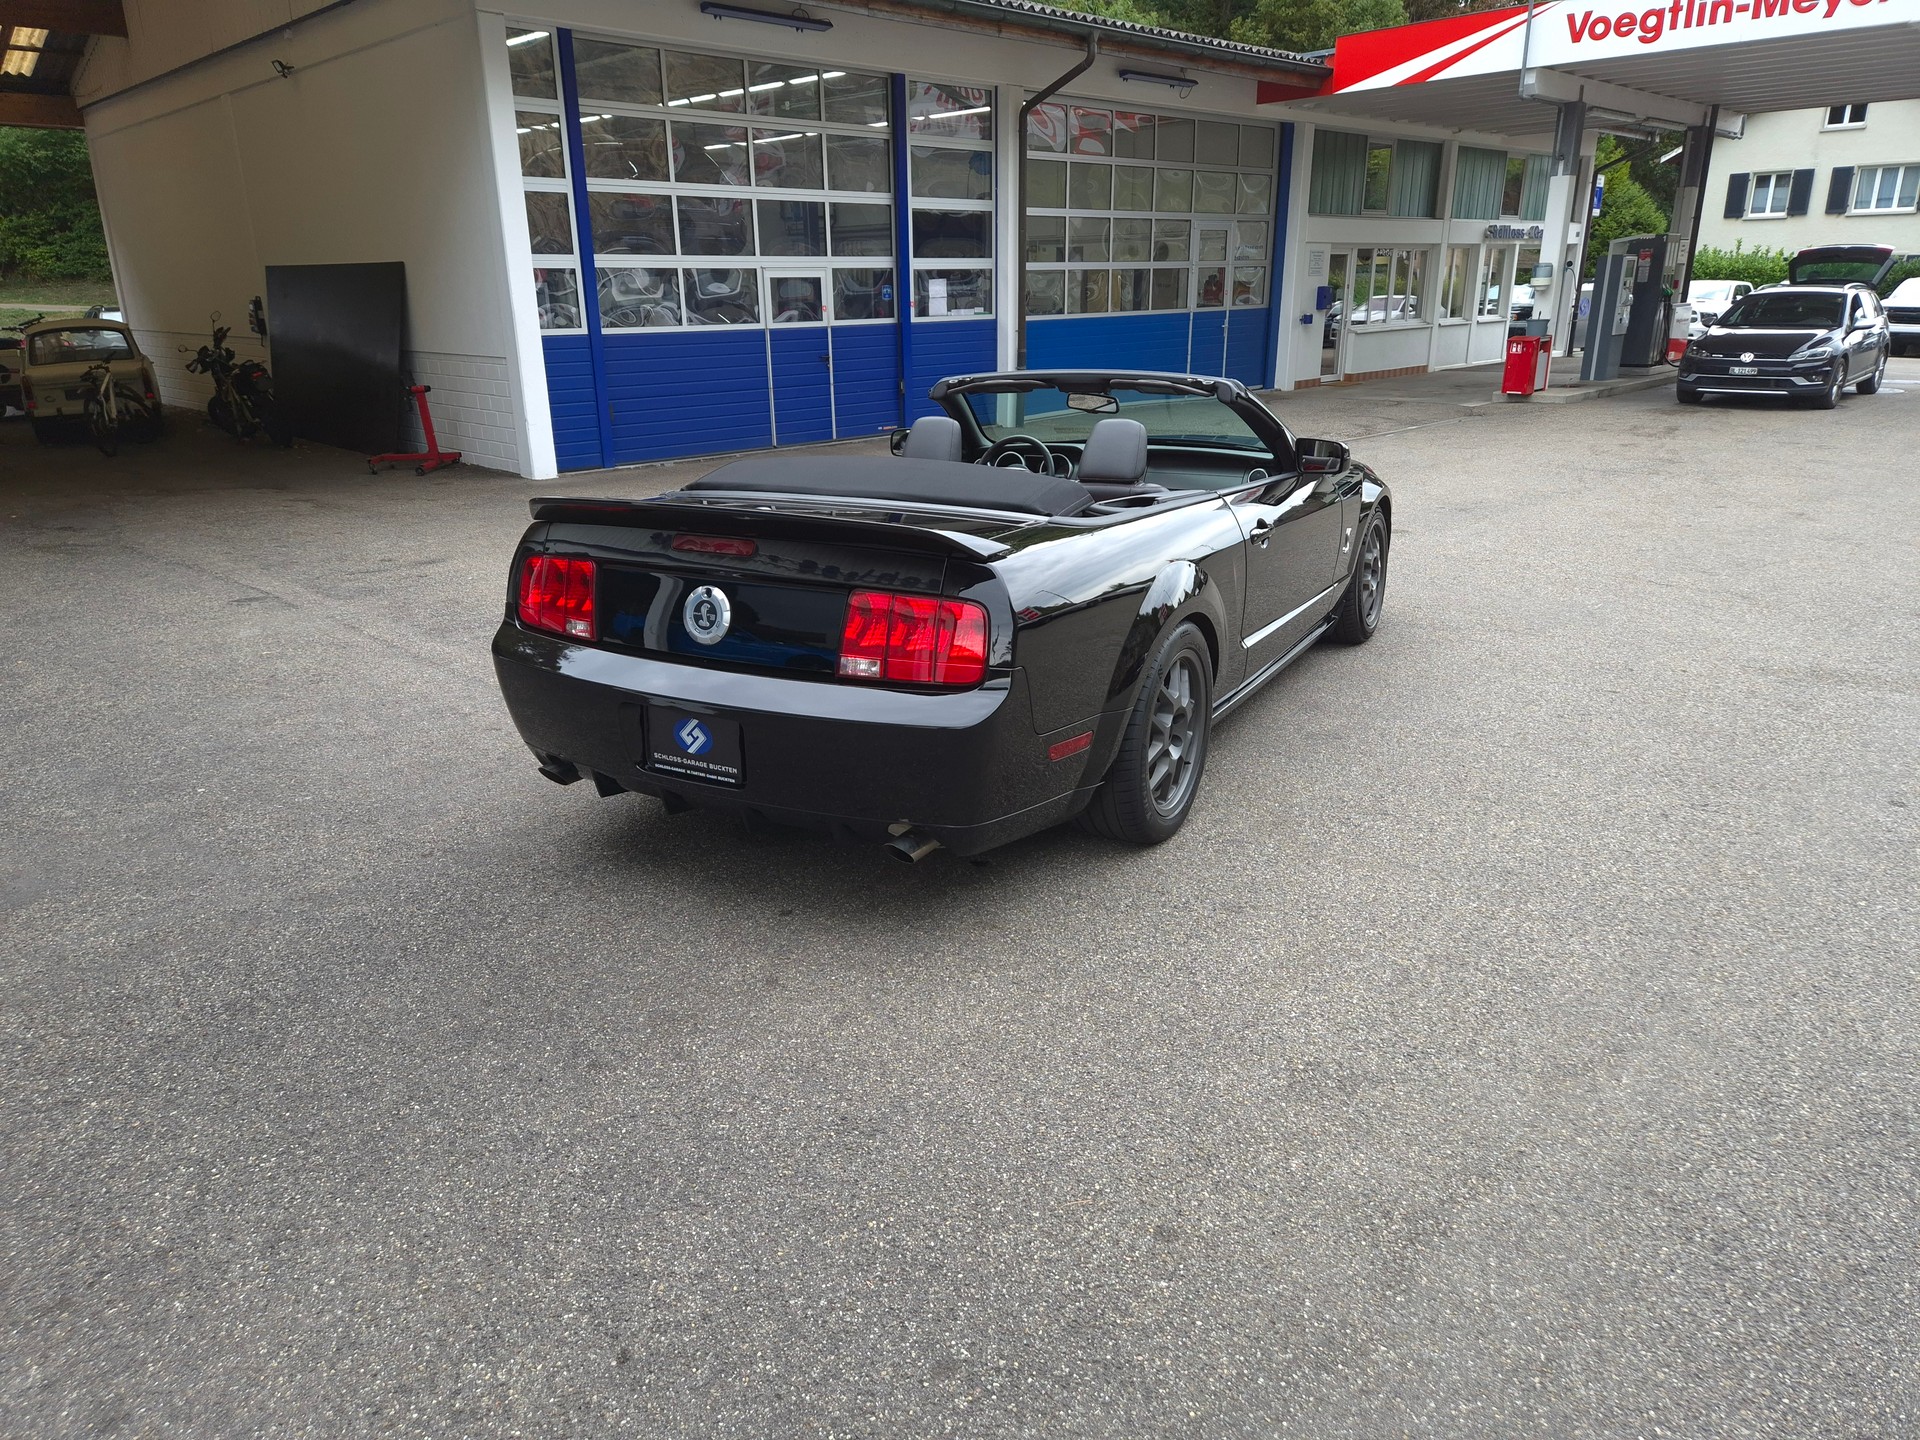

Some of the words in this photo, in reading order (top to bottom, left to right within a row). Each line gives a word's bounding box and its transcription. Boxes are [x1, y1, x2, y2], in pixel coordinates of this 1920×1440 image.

[1566, 0, 1890, 44] Voegtlin-Mey
[653, 752, 708, 768] SCHLOSS-GARAGE
[709, 763, 738, 774] BUCKTEN
